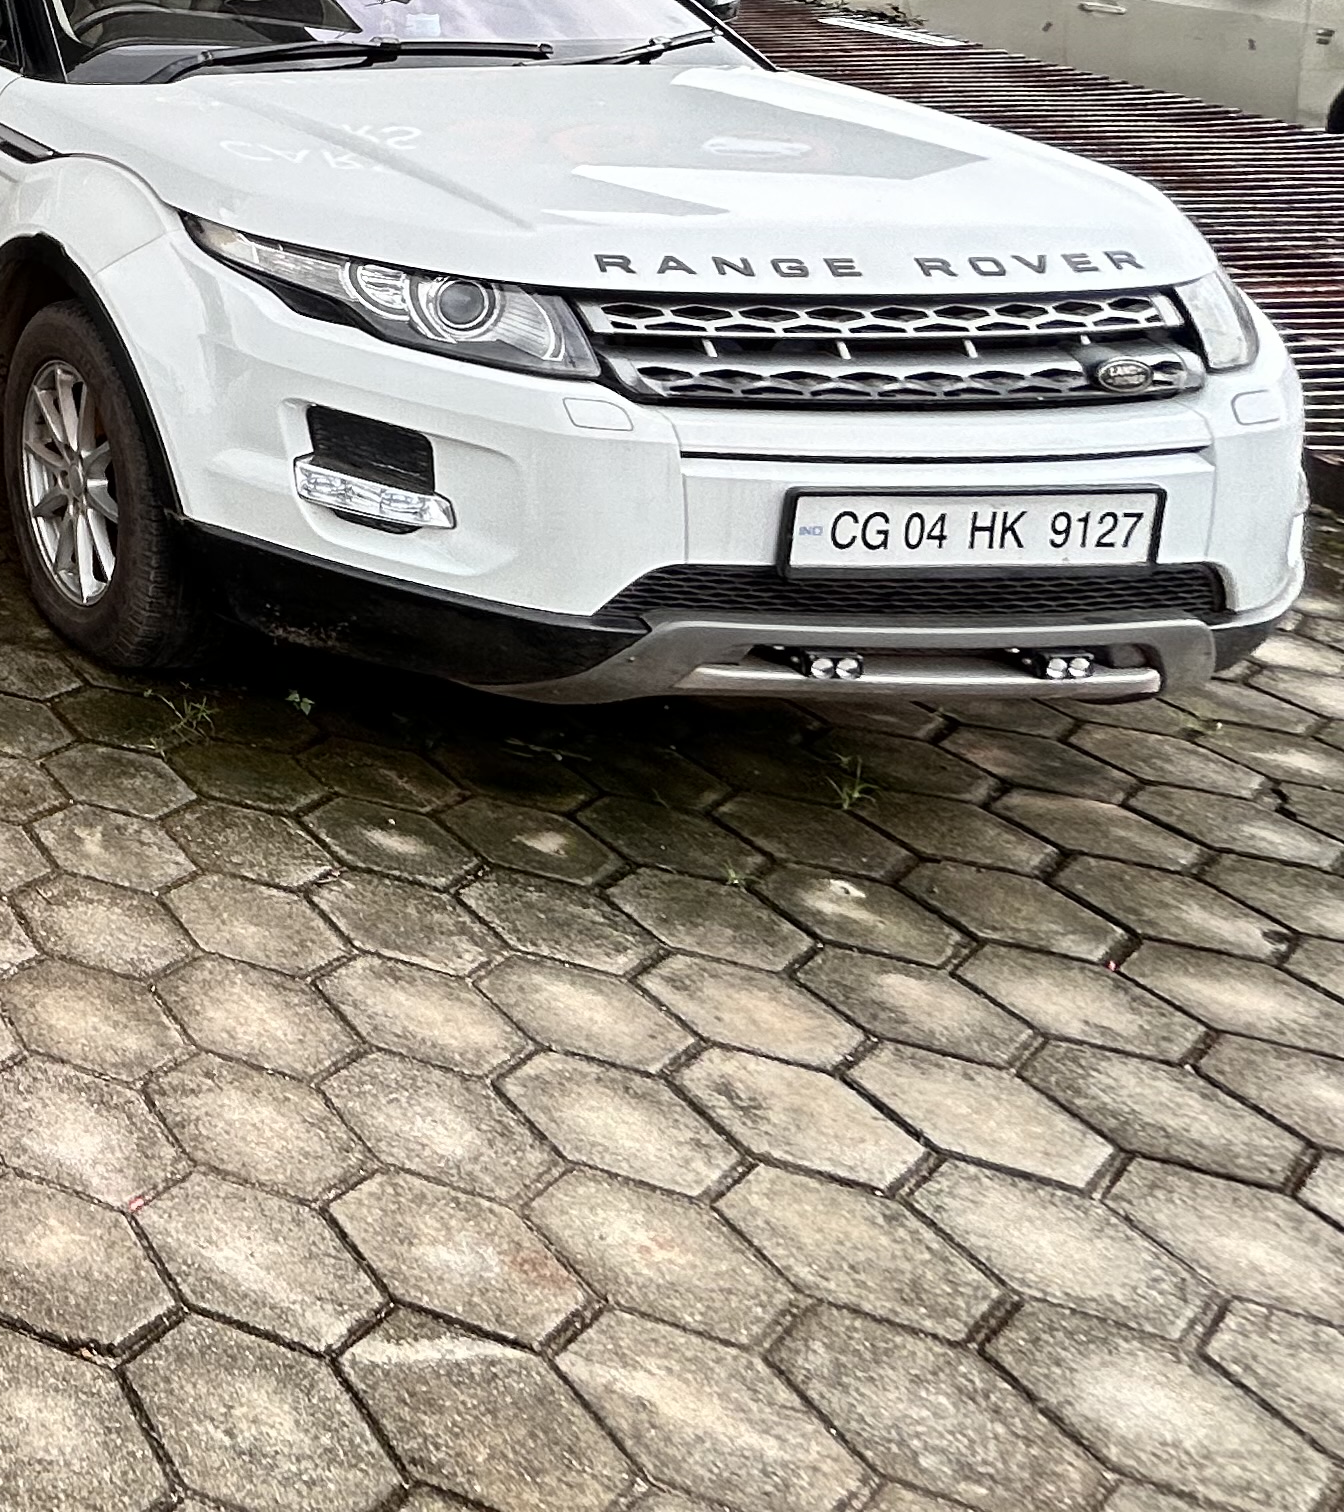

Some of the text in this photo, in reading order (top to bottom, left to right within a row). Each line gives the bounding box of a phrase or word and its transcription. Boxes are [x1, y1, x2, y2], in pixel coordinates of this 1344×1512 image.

[593, 249, 1145, 279] RANGE ROVER
[798, 510, 1145, 550] IND CG 04 HK 9127
